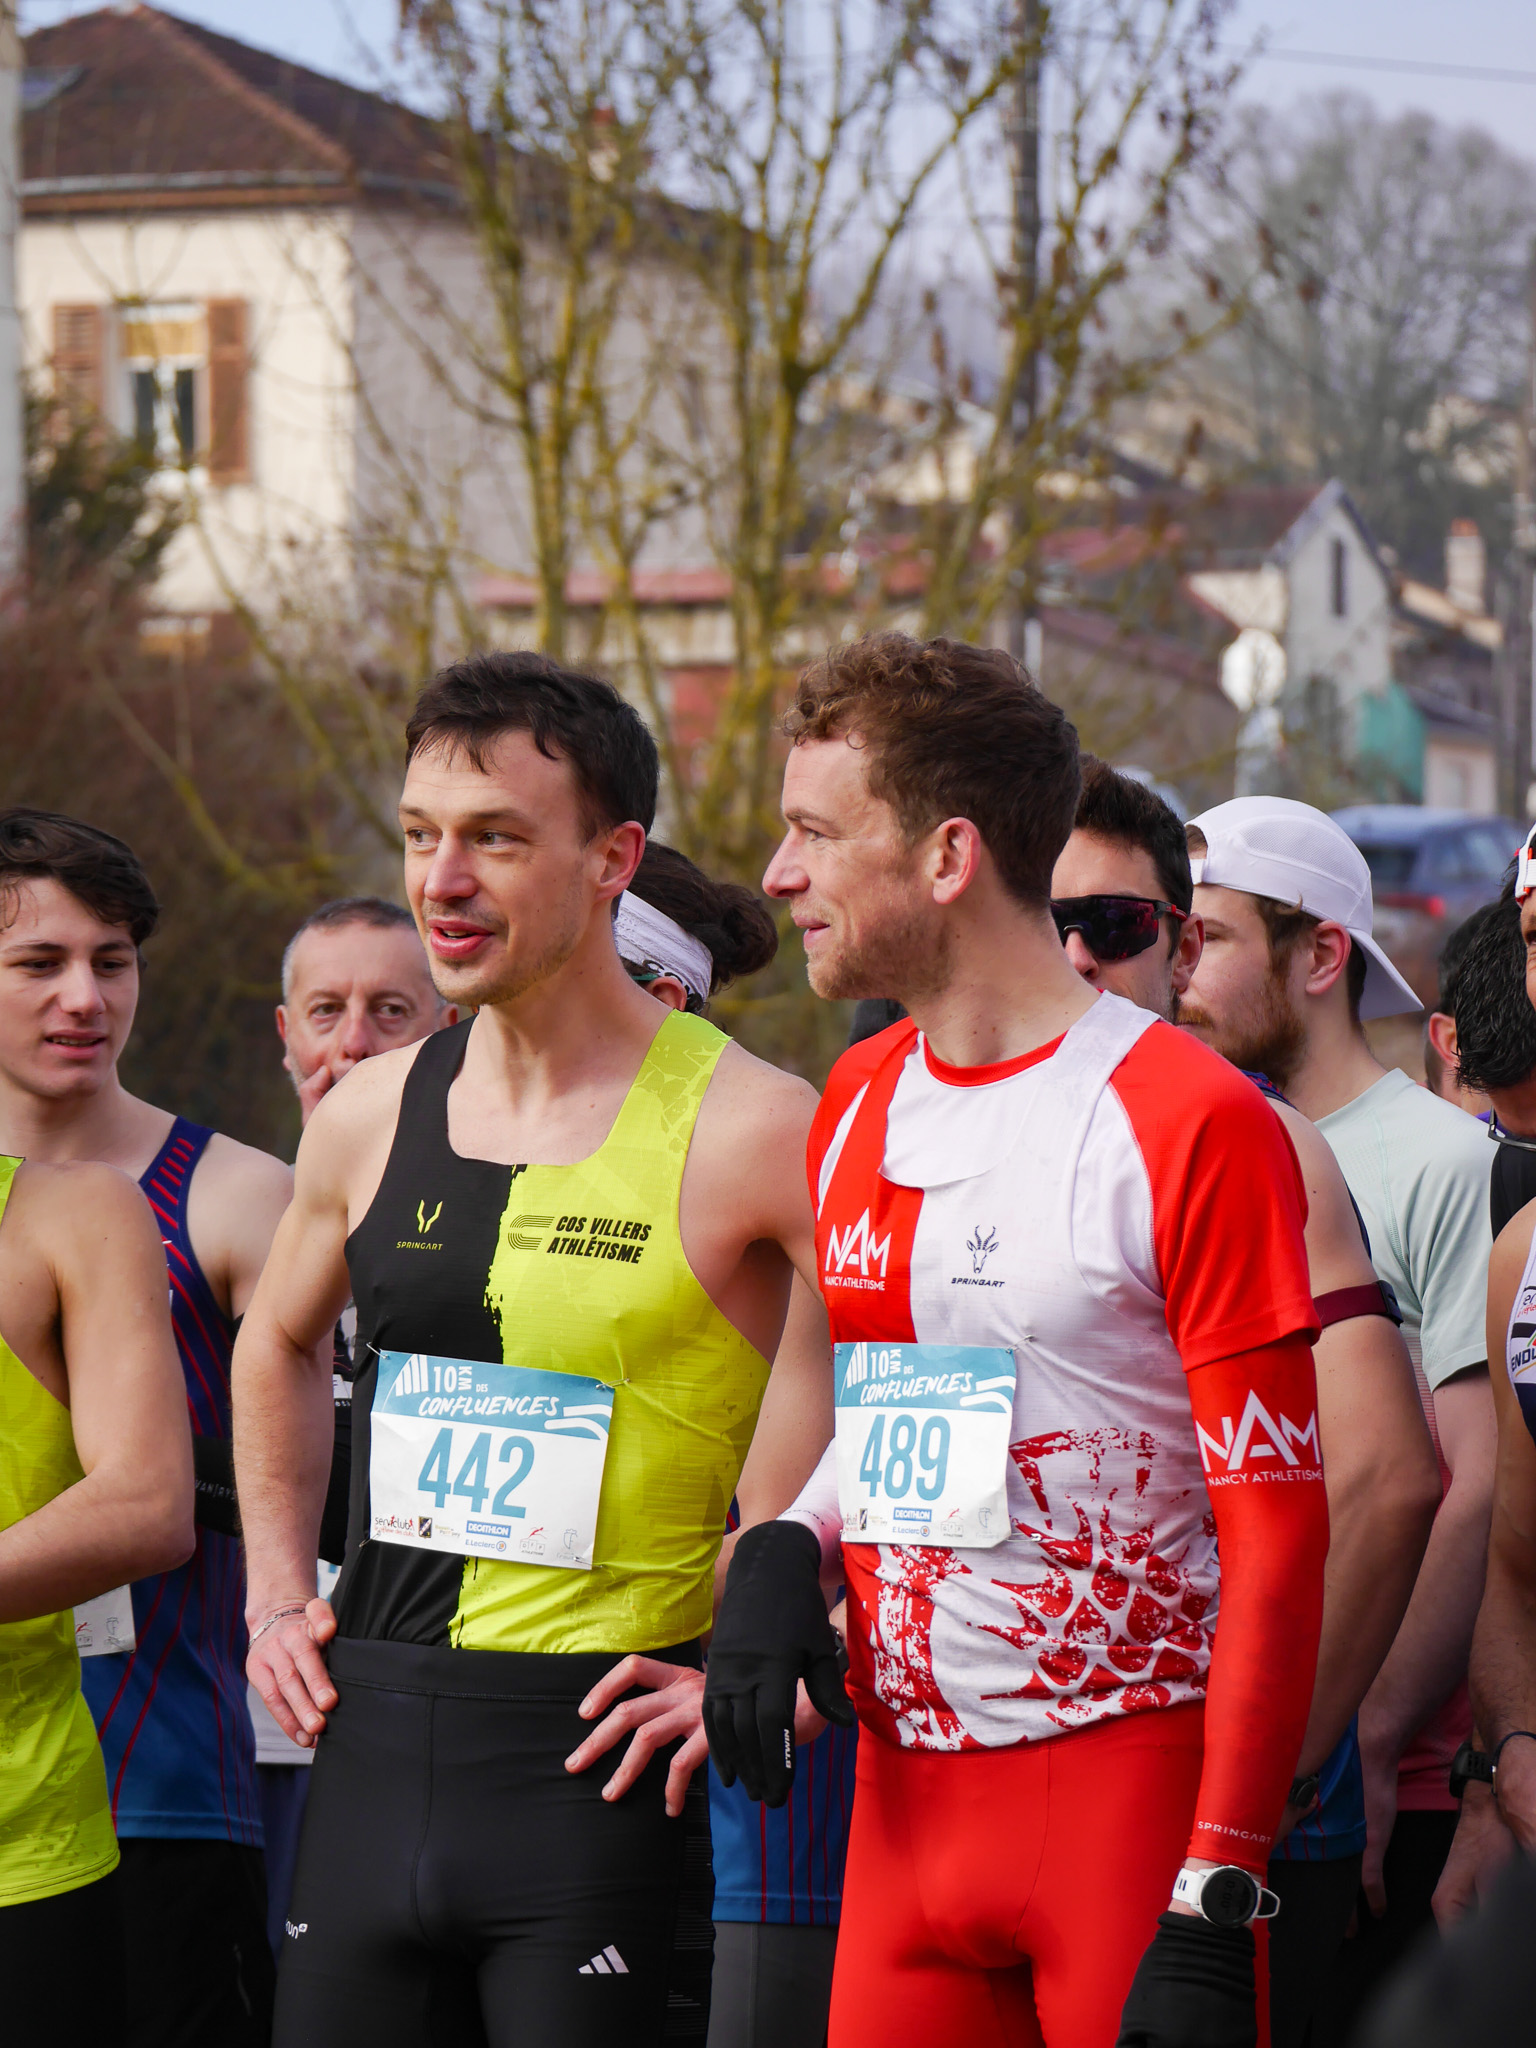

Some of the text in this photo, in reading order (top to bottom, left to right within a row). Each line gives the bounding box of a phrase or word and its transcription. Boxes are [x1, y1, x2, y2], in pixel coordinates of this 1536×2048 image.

[555, 1216, 652, 1241] COS VILLERS
[396, 1240, 444, 1251] SPRINGART
[546, 1235, 645, 1264] ATHLÉTISME
[825, 1207, 892, 1278] NAM
[824, 1275, 886, 1292] NANCY ATHLETISME
[951, 1277, 1006, 1288] SPRINGART
[870, 1349, 914, 1380] 10 KM DES
[433, 1365, 489, 1393] 10 KM DES
[860, 1372, 974, 1405] CONFLUENCES
[418, 1395, 560, 1417] CONFLUENCES
[1195, 1388, 1321, 1473] NAM
[859, 1413, 951, 1501] 489
[418, 1427, 535, 1519] 442
[1208, 1469, 1323, 1487] NANCY ATHLETISME
[895, 1510, 931, 1520] DECATHLON
[467, 1522, 509, 1536] DECATHLON
[1197, 1820, 1272, 1844] SPRINGART
